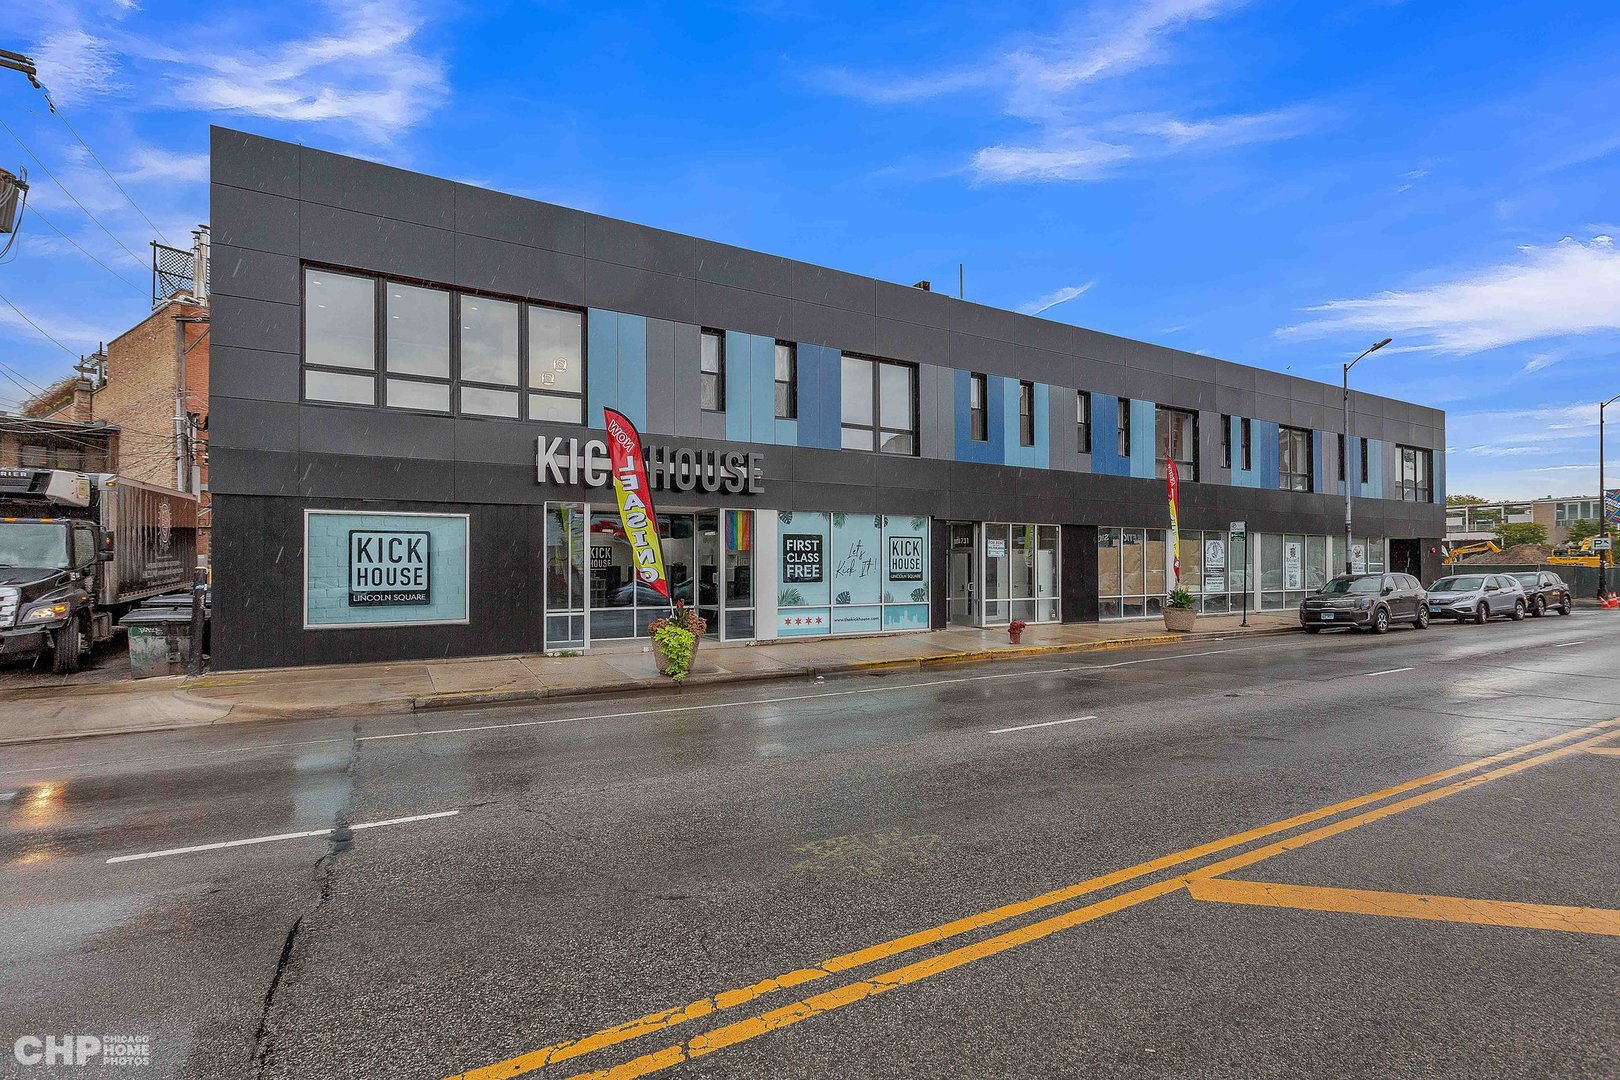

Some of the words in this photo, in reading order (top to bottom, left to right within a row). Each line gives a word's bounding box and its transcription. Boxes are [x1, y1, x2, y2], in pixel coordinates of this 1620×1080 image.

[537, 435, 615, 487] KIC
[649, 445, 765, 493] HOUSE
[357, 537, 423, 563] KICK
[786, 539, 820, 551] FIRST
[892, 540, 920, 556] KICK
[590, 547, 611, 559] KICK
[786, 552, 820, 563] CLASS
[786, 564, 820, 578] FREE
[835, 559, 857, 579] Kick
[892, 558, 920, 570] HOUSE
[357, 567, 423, 587] HOUSE
[353, 594, 391, 602] LINCOLN
[393, 593, 426, 601] SQUARE
